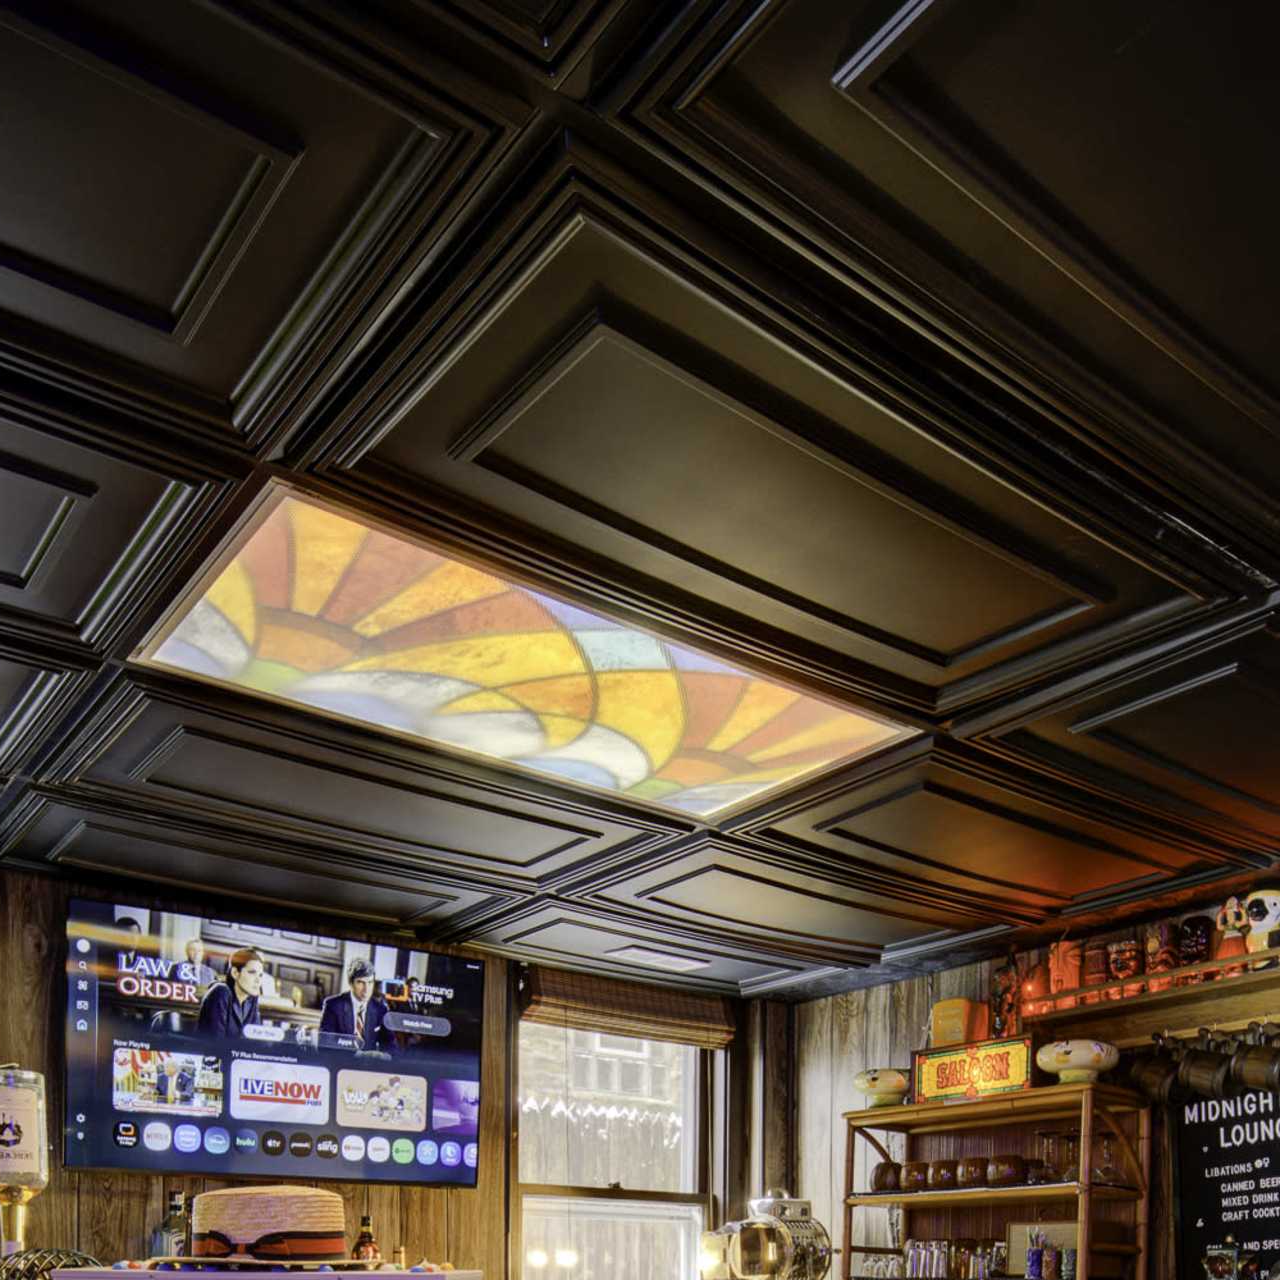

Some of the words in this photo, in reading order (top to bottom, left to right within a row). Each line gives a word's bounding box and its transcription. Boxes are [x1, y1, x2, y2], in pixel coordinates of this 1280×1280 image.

[117, 952, 172, 977] LAW
[177, 962, 200, 984] &
[117, 977, 199, 1002] ORDER
[411, 982, 453, 998] Samsung
[412, 993, 423, 1003] TV
[424, 994, 443, 1005] Plus
[937, 1052, 1009, 1089] SALOON
[236, 1137, 256, 1147] hulu
[317, 1141, 338, 1154] sling
[1205, 1162, 1253, 1178] LIBATIONS
[1221, 1180, 1255, 1193] CANNED
[1221, 1195, 1249, 1208] MIXED
[1252, 1192, 1280, 1204] DRINK
[1222, 1209, 1250, 1222] CRAFT
